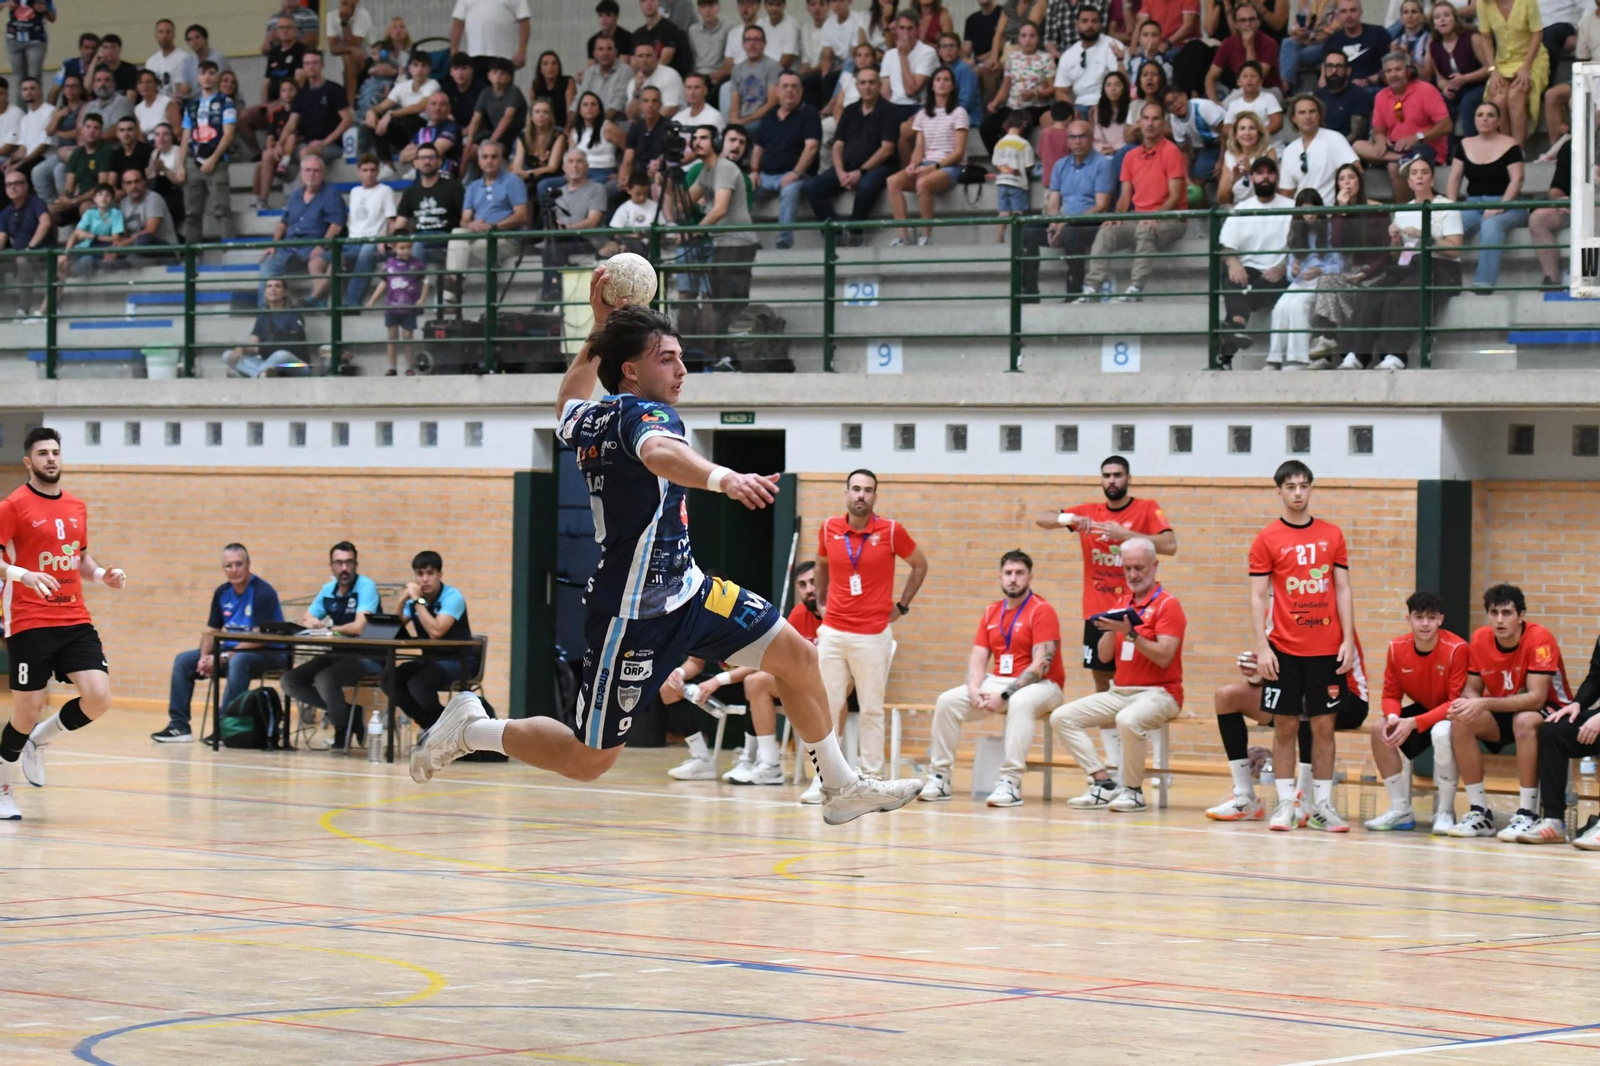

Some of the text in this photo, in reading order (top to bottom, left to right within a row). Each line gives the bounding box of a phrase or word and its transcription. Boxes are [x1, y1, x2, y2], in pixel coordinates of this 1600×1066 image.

[1581, 247, 1599, 277] W
[848, 282, 875, 306] 29
[878, 343, 892, 366] 9
[1113, 341, 1129, 366] 8
[55, 518, 65, 540] 8
[1295, 543, 1316, 565] 27
[1296, 615, 1332, 628] Cajasol
[18, 662, 28, 685] 8
[624, 666, 644, 676] ORP
[1264, 686, 1281, 709] 27
[617, 716, 633, 736] 9
